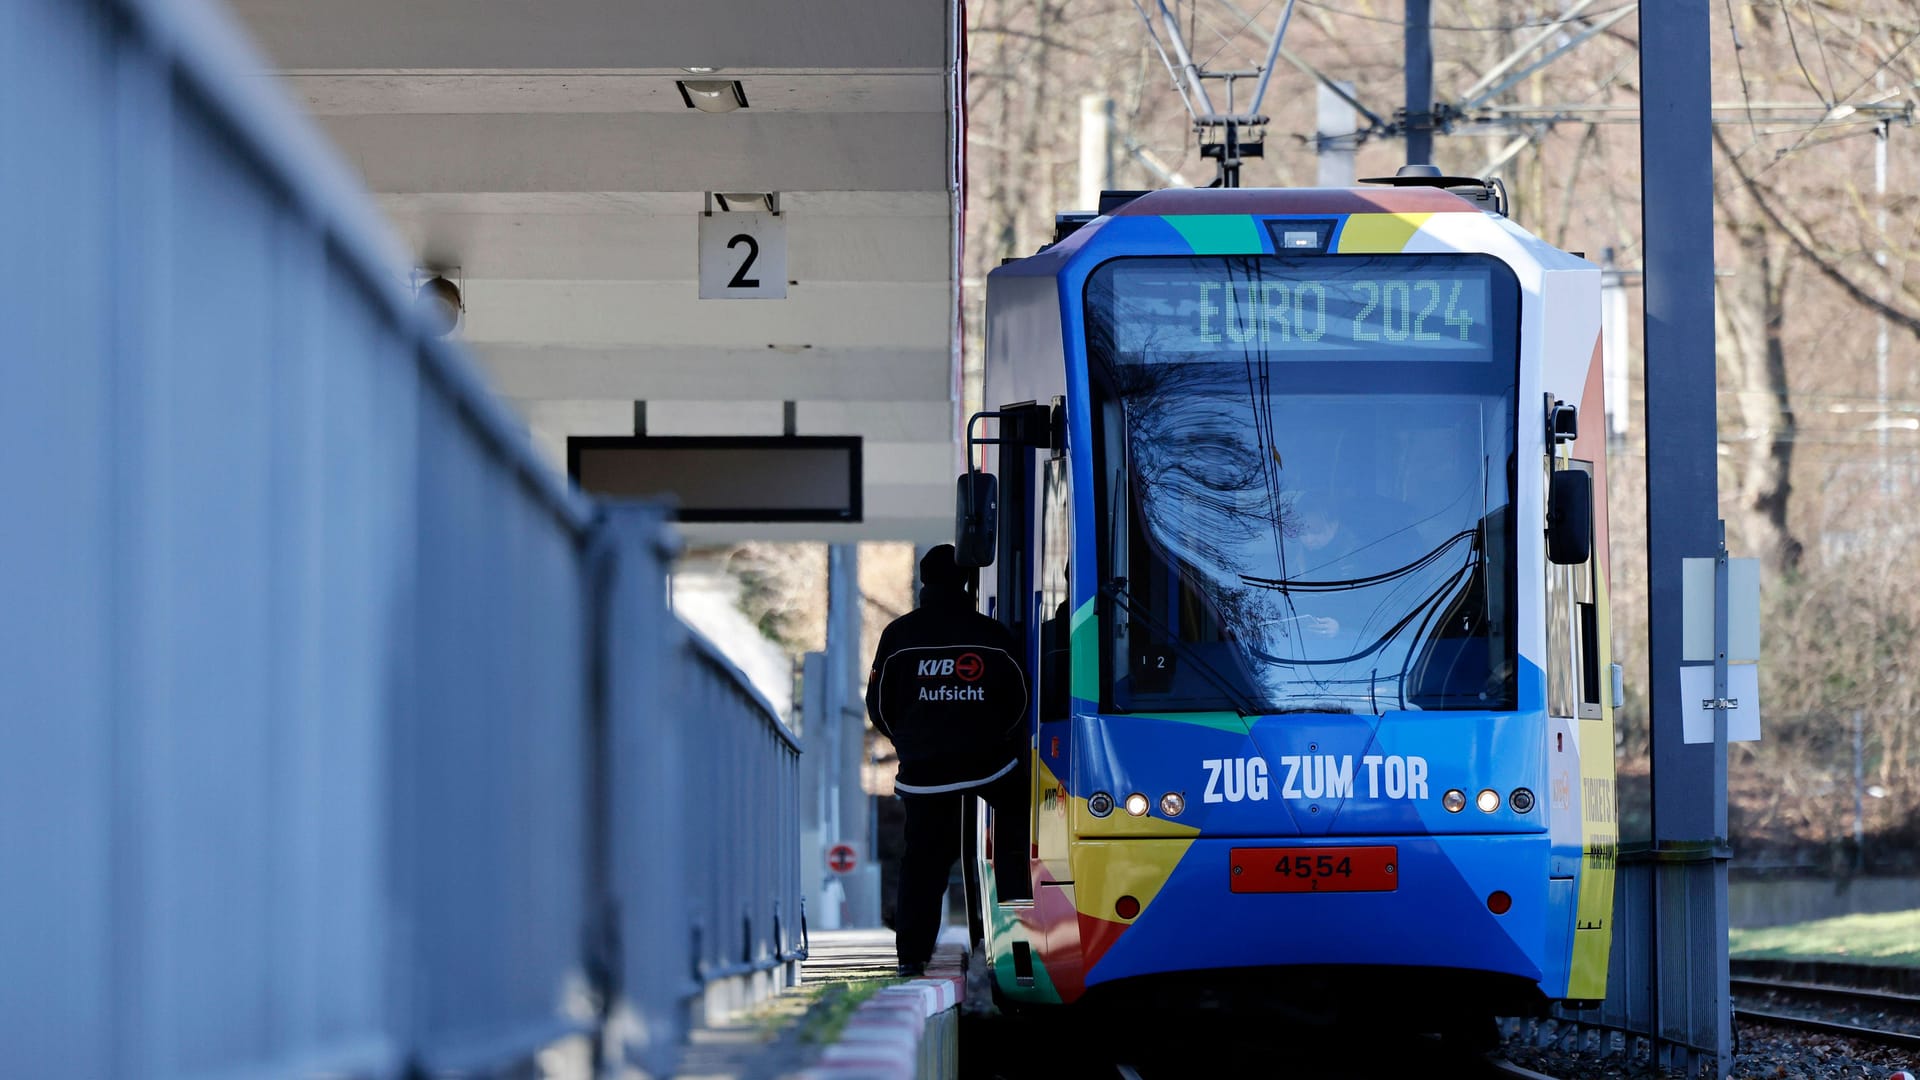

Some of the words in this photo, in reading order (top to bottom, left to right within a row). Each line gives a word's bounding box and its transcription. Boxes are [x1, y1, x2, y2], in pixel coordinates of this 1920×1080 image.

[727, 233, 759, 288] 2
[1199, 281, 1327, 343] EURO
[1351, 280, 1474, 341] 2024
[917, 659, 955, 676] KVB
[918, 685, 985, 701] Aufsicht
[1203, 757, 1269, 803] ZUG
[1281, 755, 1354, 799] ZUM
[1363, 755, 1428, 799] TOR
[1275, 856, 1352, 877] 4554
